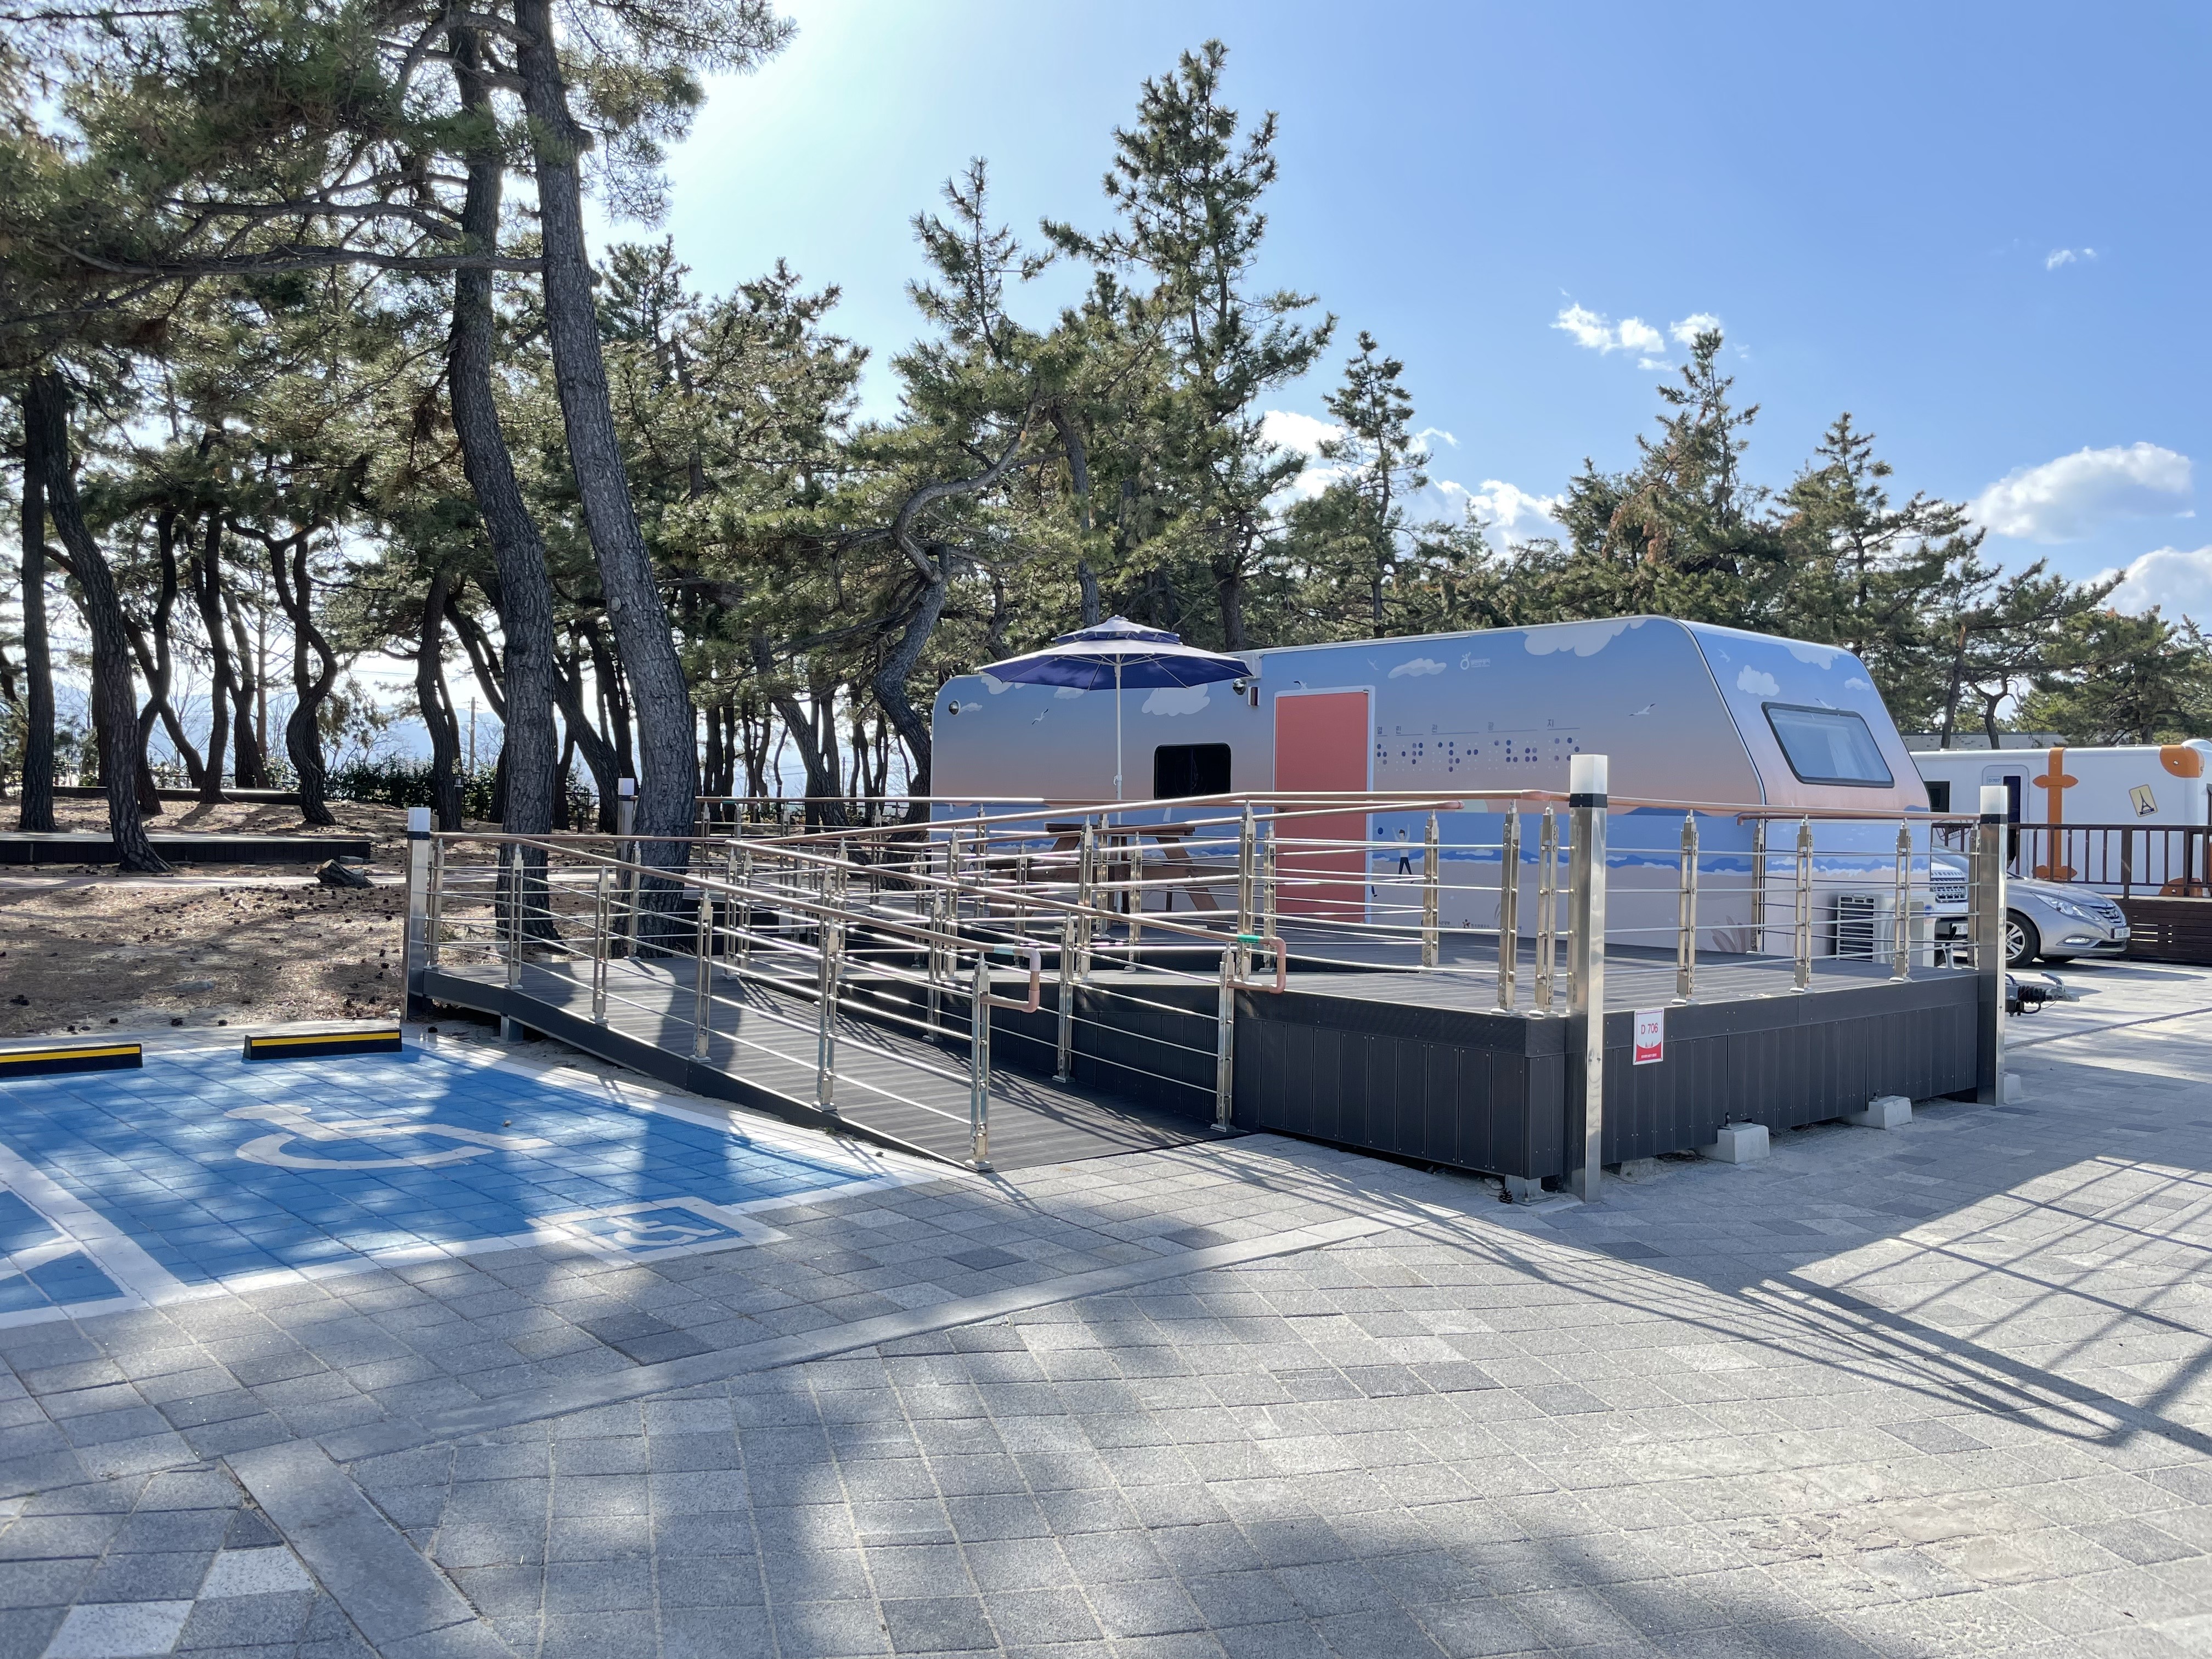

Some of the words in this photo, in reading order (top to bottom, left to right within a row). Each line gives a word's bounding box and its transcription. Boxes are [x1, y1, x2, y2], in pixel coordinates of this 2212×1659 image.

[1547, 719, 1554, 728] 지
[1641, 1024, 1645, 1035] D
[1647, 1023, 1658, 1034] 706
